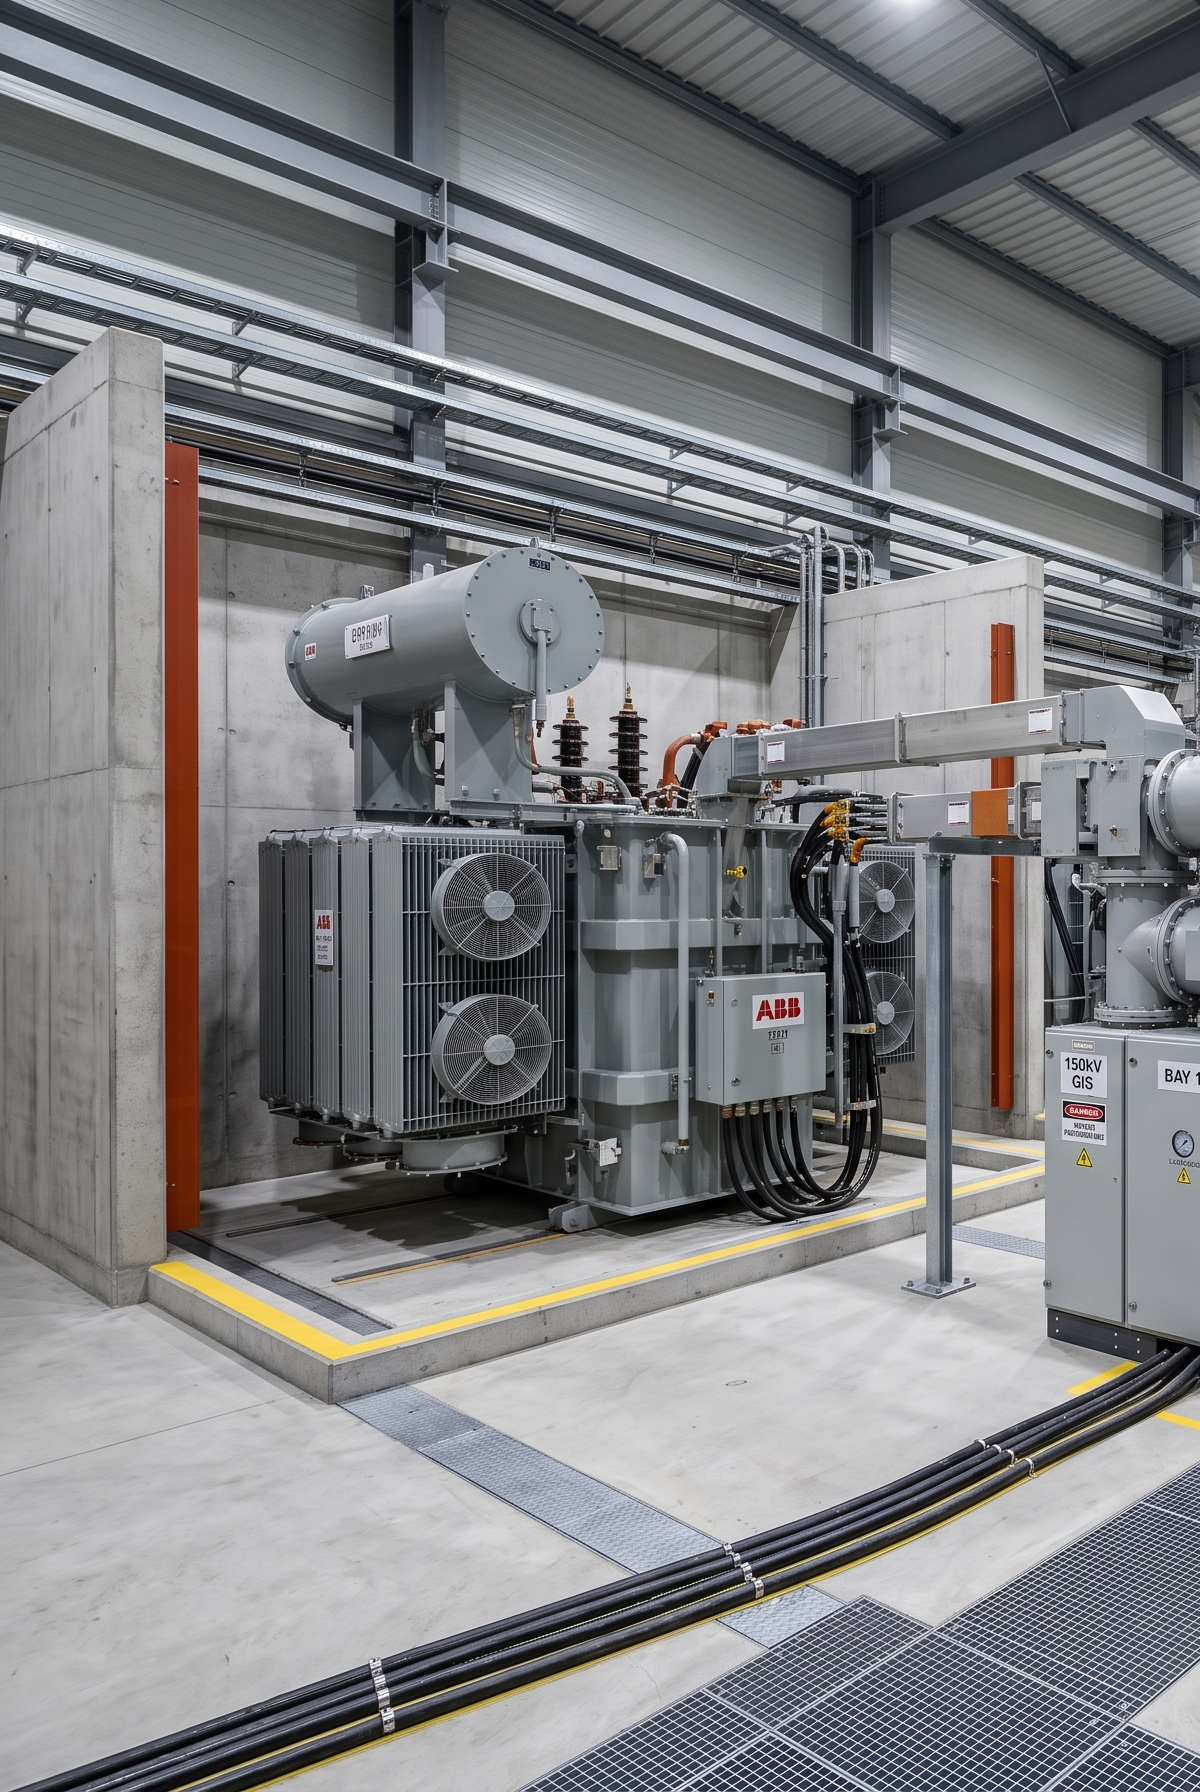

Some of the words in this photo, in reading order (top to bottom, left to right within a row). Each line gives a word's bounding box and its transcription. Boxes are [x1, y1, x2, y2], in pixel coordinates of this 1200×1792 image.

[756, 997, 801, 1022] ABB
[1064, 1056, 1102, 1073] 150kV
[1072, 1074, 1094, 1090] GIS
[1164, 1068, 1191, 1084] BAY
[1195, 1071, 1200, 1086] 1
